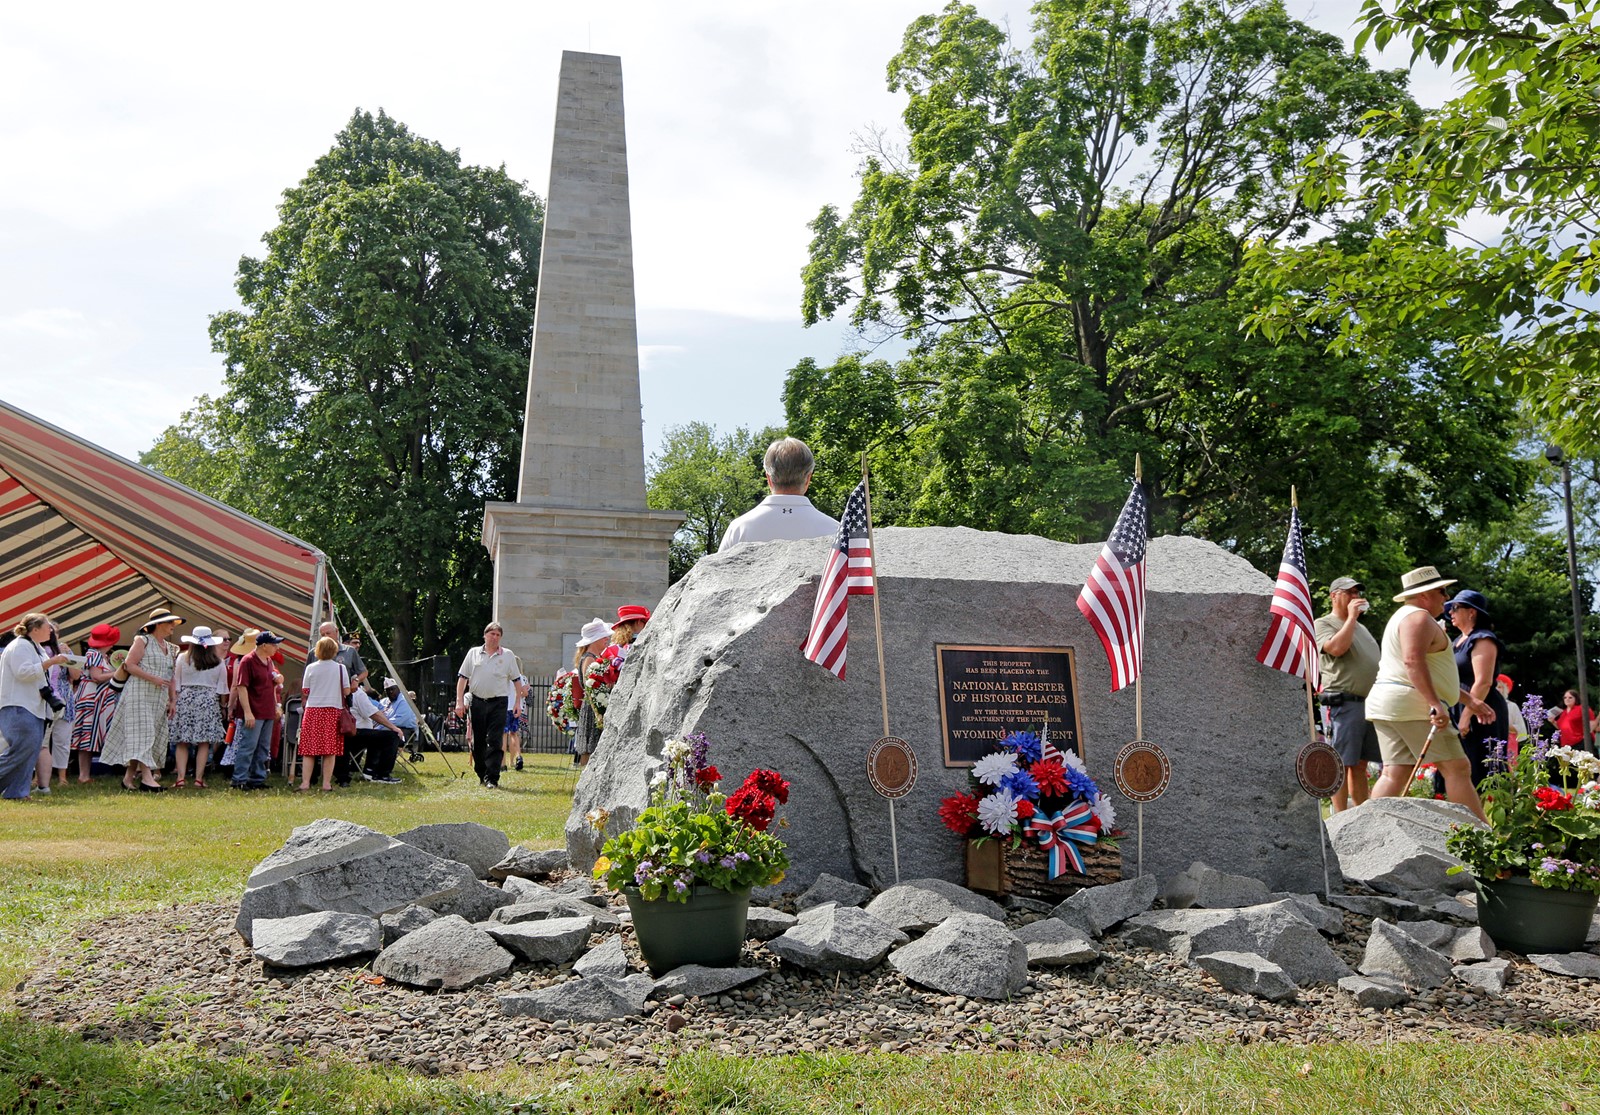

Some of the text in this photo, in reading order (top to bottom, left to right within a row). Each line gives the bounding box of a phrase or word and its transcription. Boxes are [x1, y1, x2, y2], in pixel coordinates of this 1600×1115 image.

[952, 681, 1065, 692] NATIONAL REGISTER
[952, 693, 1068, 704] OF HISTORIC PLACES
